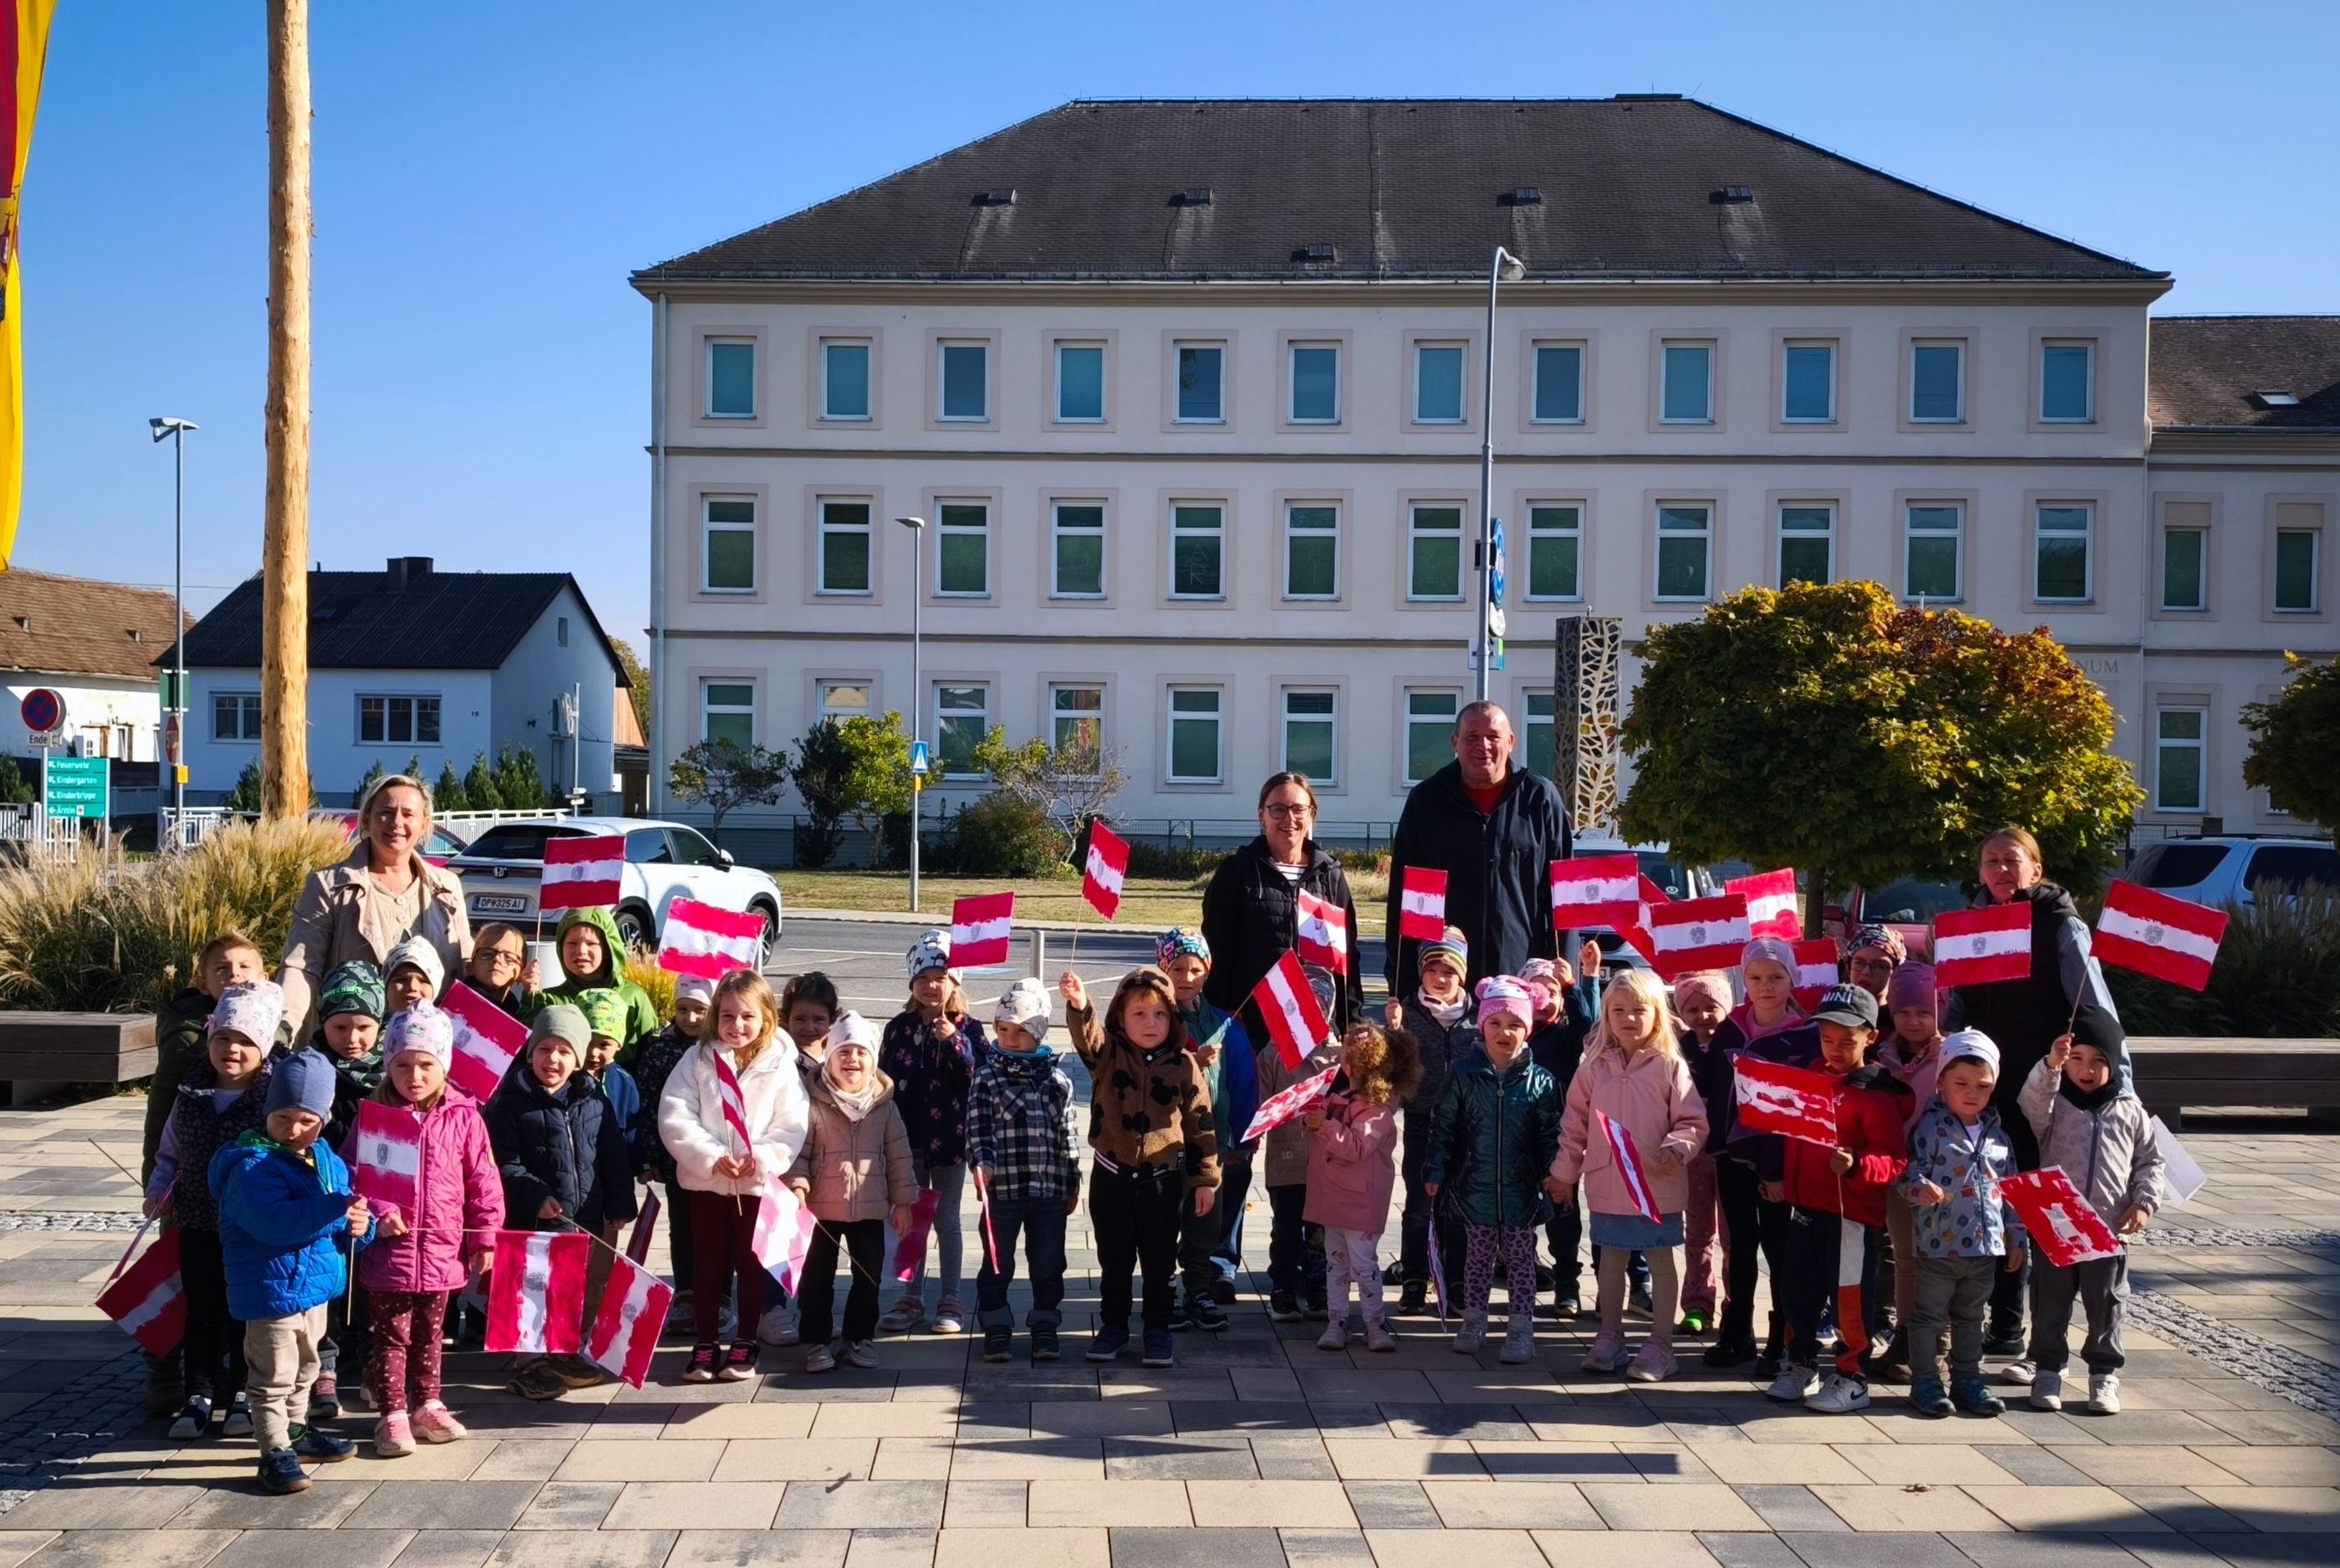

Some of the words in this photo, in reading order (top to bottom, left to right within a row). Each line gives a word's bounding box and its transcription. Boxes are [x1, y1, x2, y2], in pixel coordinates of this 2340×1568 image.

[29, 735, 48, 744] Ende
[57, 761, 89, 769] Feuerwehr
[57, 776, 97, 786] Kindergarten
[57, 791, 96, 801] Kinderkrippe
